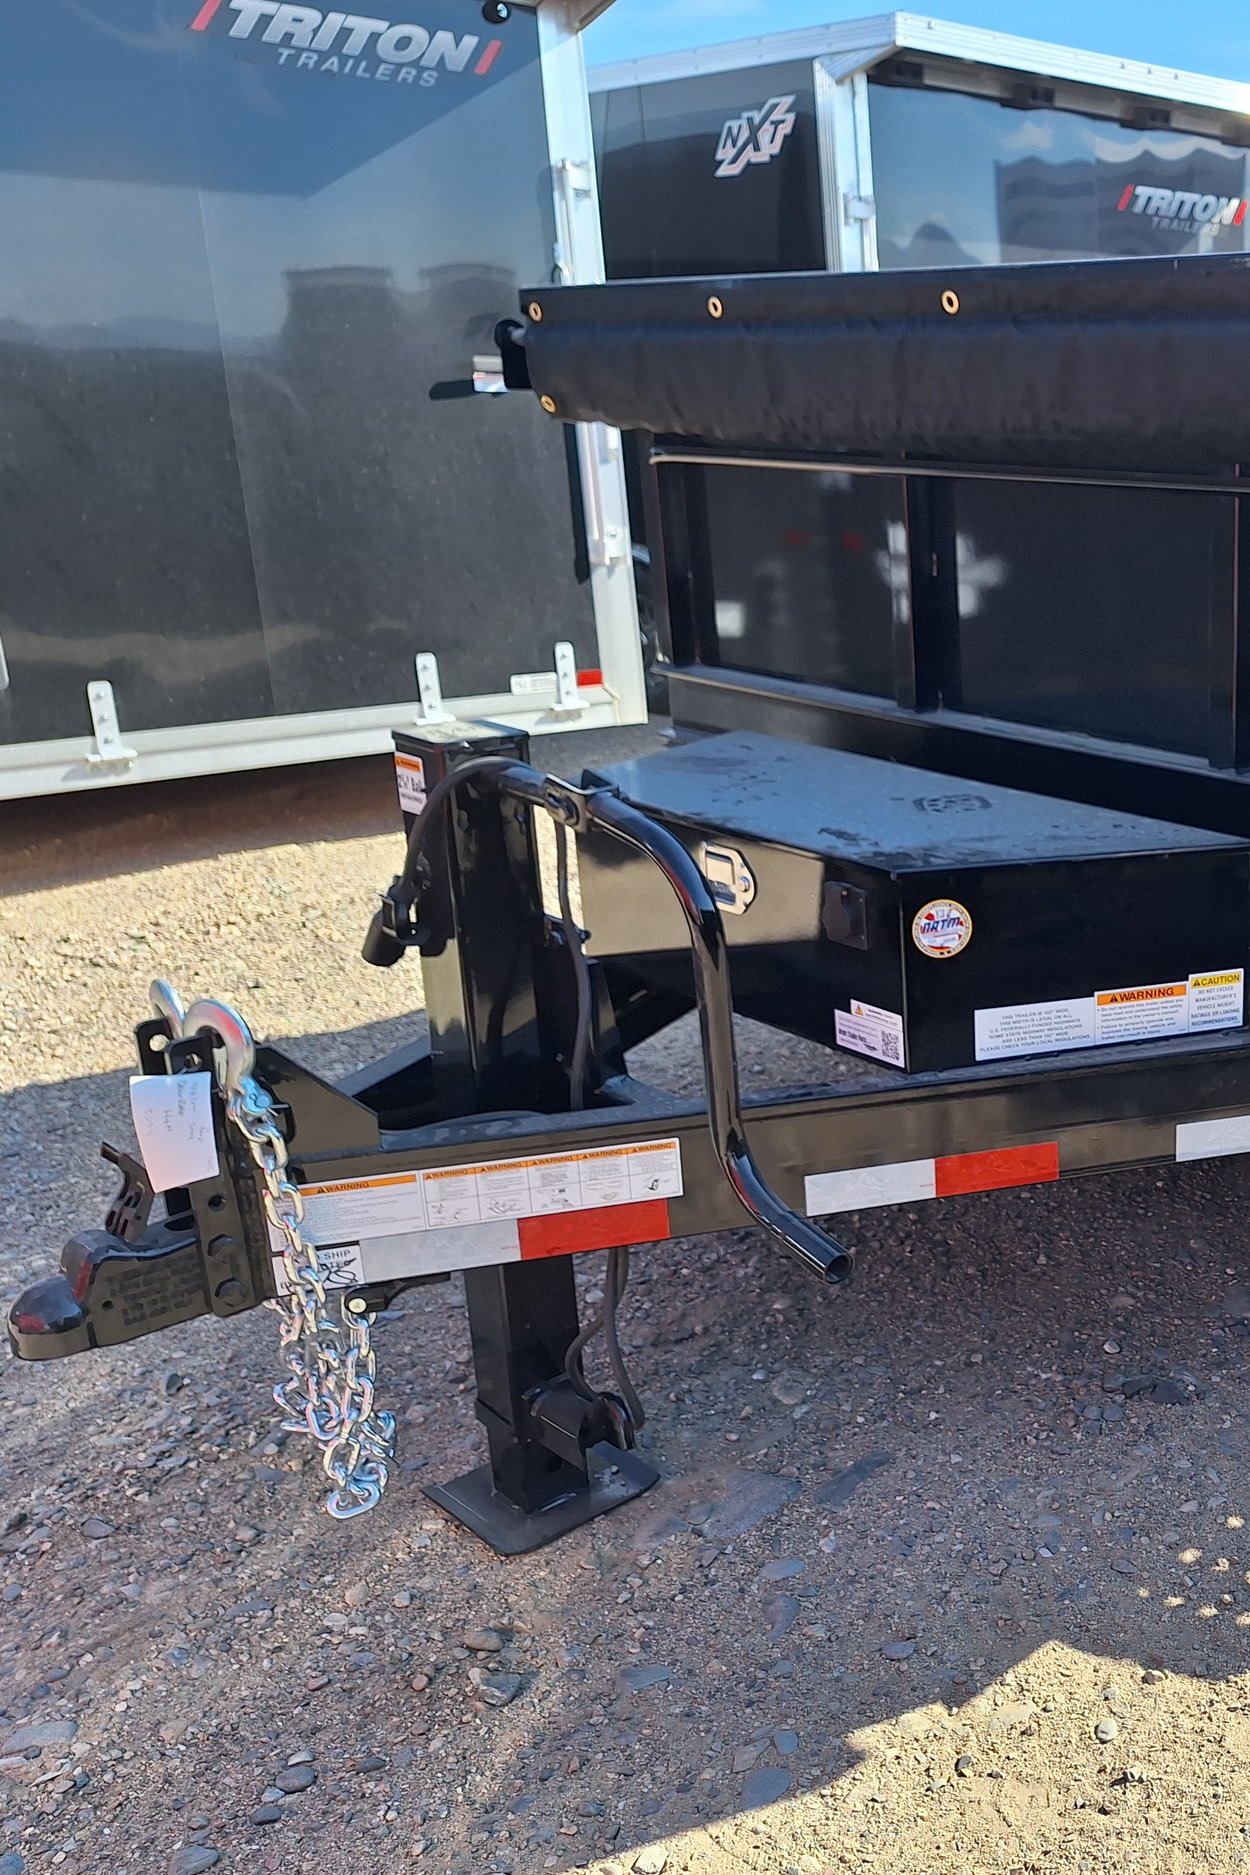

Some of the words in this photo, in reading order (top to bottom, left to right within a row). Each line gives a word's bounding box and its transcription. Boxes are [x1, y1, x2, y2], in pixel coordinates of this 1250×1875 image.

[228, 0, 479, 72] TRITON
[277, 48, 438, 88] TRAILERS
[714, 95, 796, 177] NXT
[1132, 185, 1240, 225] TRITON
[1201, 974, 1240, 986] CAUTION
[1119, 987, 1174, 1001] WARNING
[638, 1143, 672, 1153] WARNING
[588, 1149, 623, 1159] WARNING
[538, 1156, 573, 1166] WARNING
[485, 1162, 521, 1172] WARNING
[433, 1169, 468, 1179] WARNING
[325, 1182, 370, 1193] WARNING
[324, 1249, 351, 1260] SHIP
